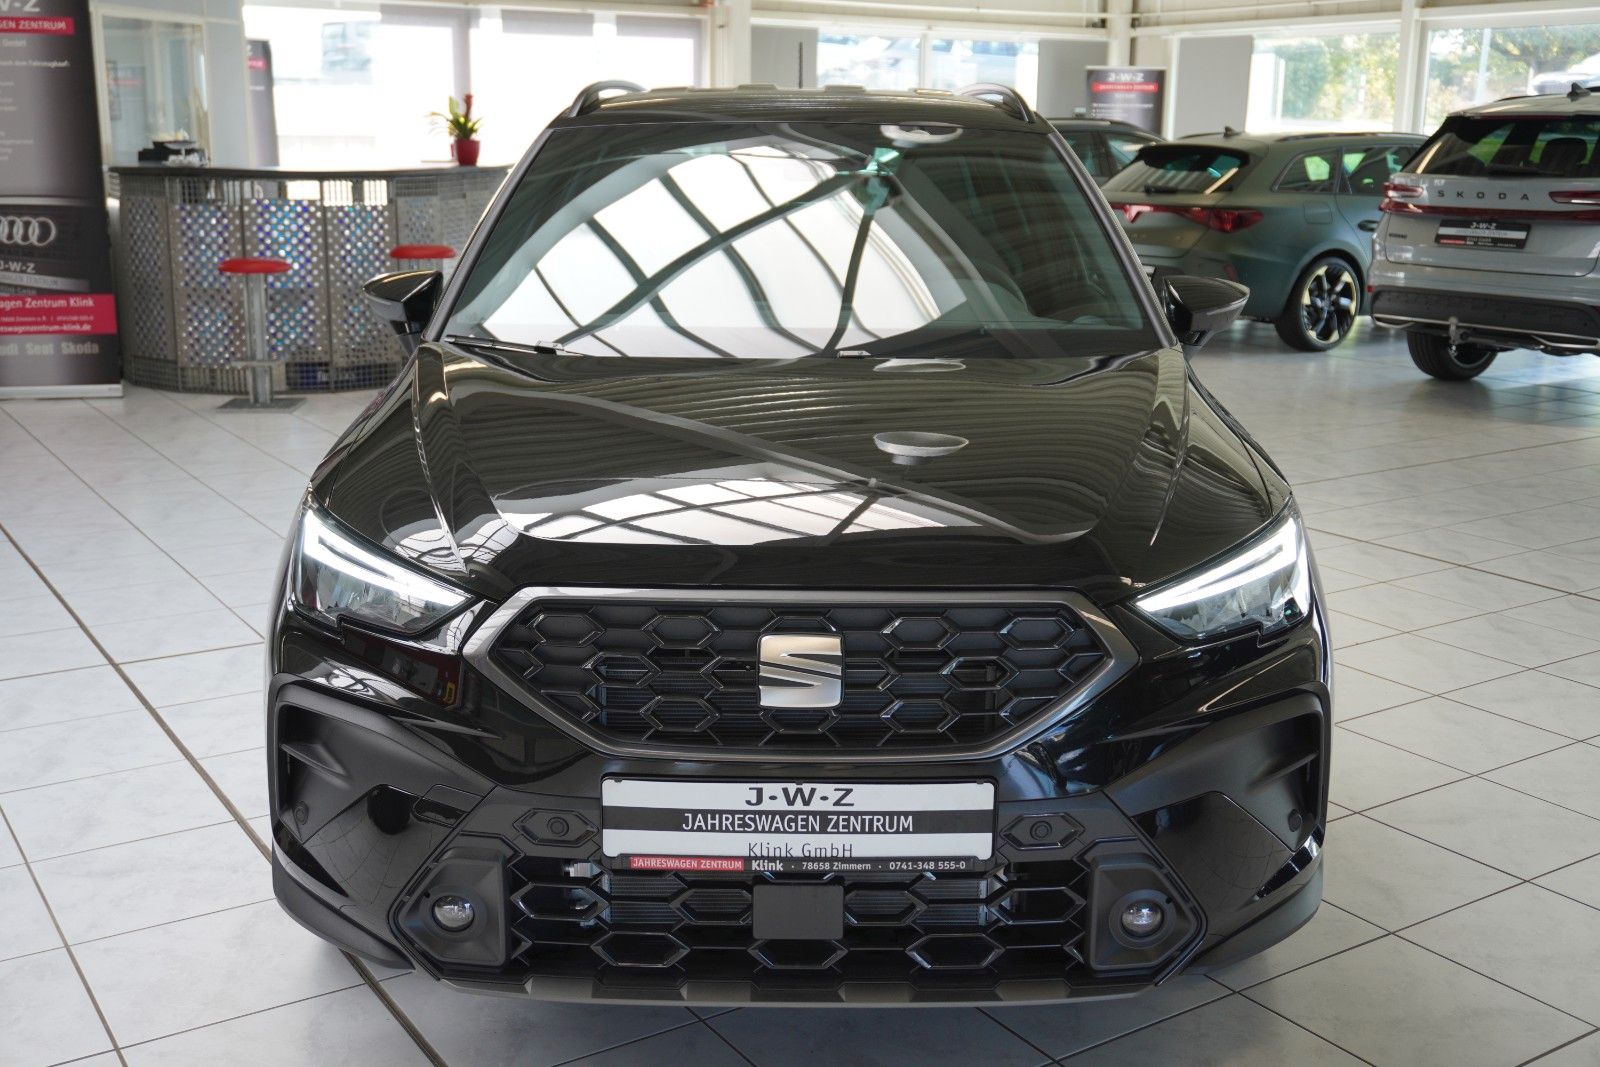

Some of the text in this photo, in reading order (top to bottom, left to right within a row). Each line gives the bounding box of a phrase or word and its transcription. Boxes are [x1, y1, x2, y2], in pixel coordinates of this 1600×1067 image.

[18, 20, 67, 30] ZENTRUM
[1437, 190, 1530, 201] SKODA
[25, 298, 67, 309] Zentrum
[69, 296, 95, 307] Klink
[61, 341, 99, 355] Skoda
[682, 813, 913, 832] JAHRESWAGEN ZENTRUM
[748, 843, 853, 858] Klink GmbH
[633, 858, 966, 871] JAHRESWAGEN ZENTRUM Klink 78658 Zimmern 0741-348 555-0
